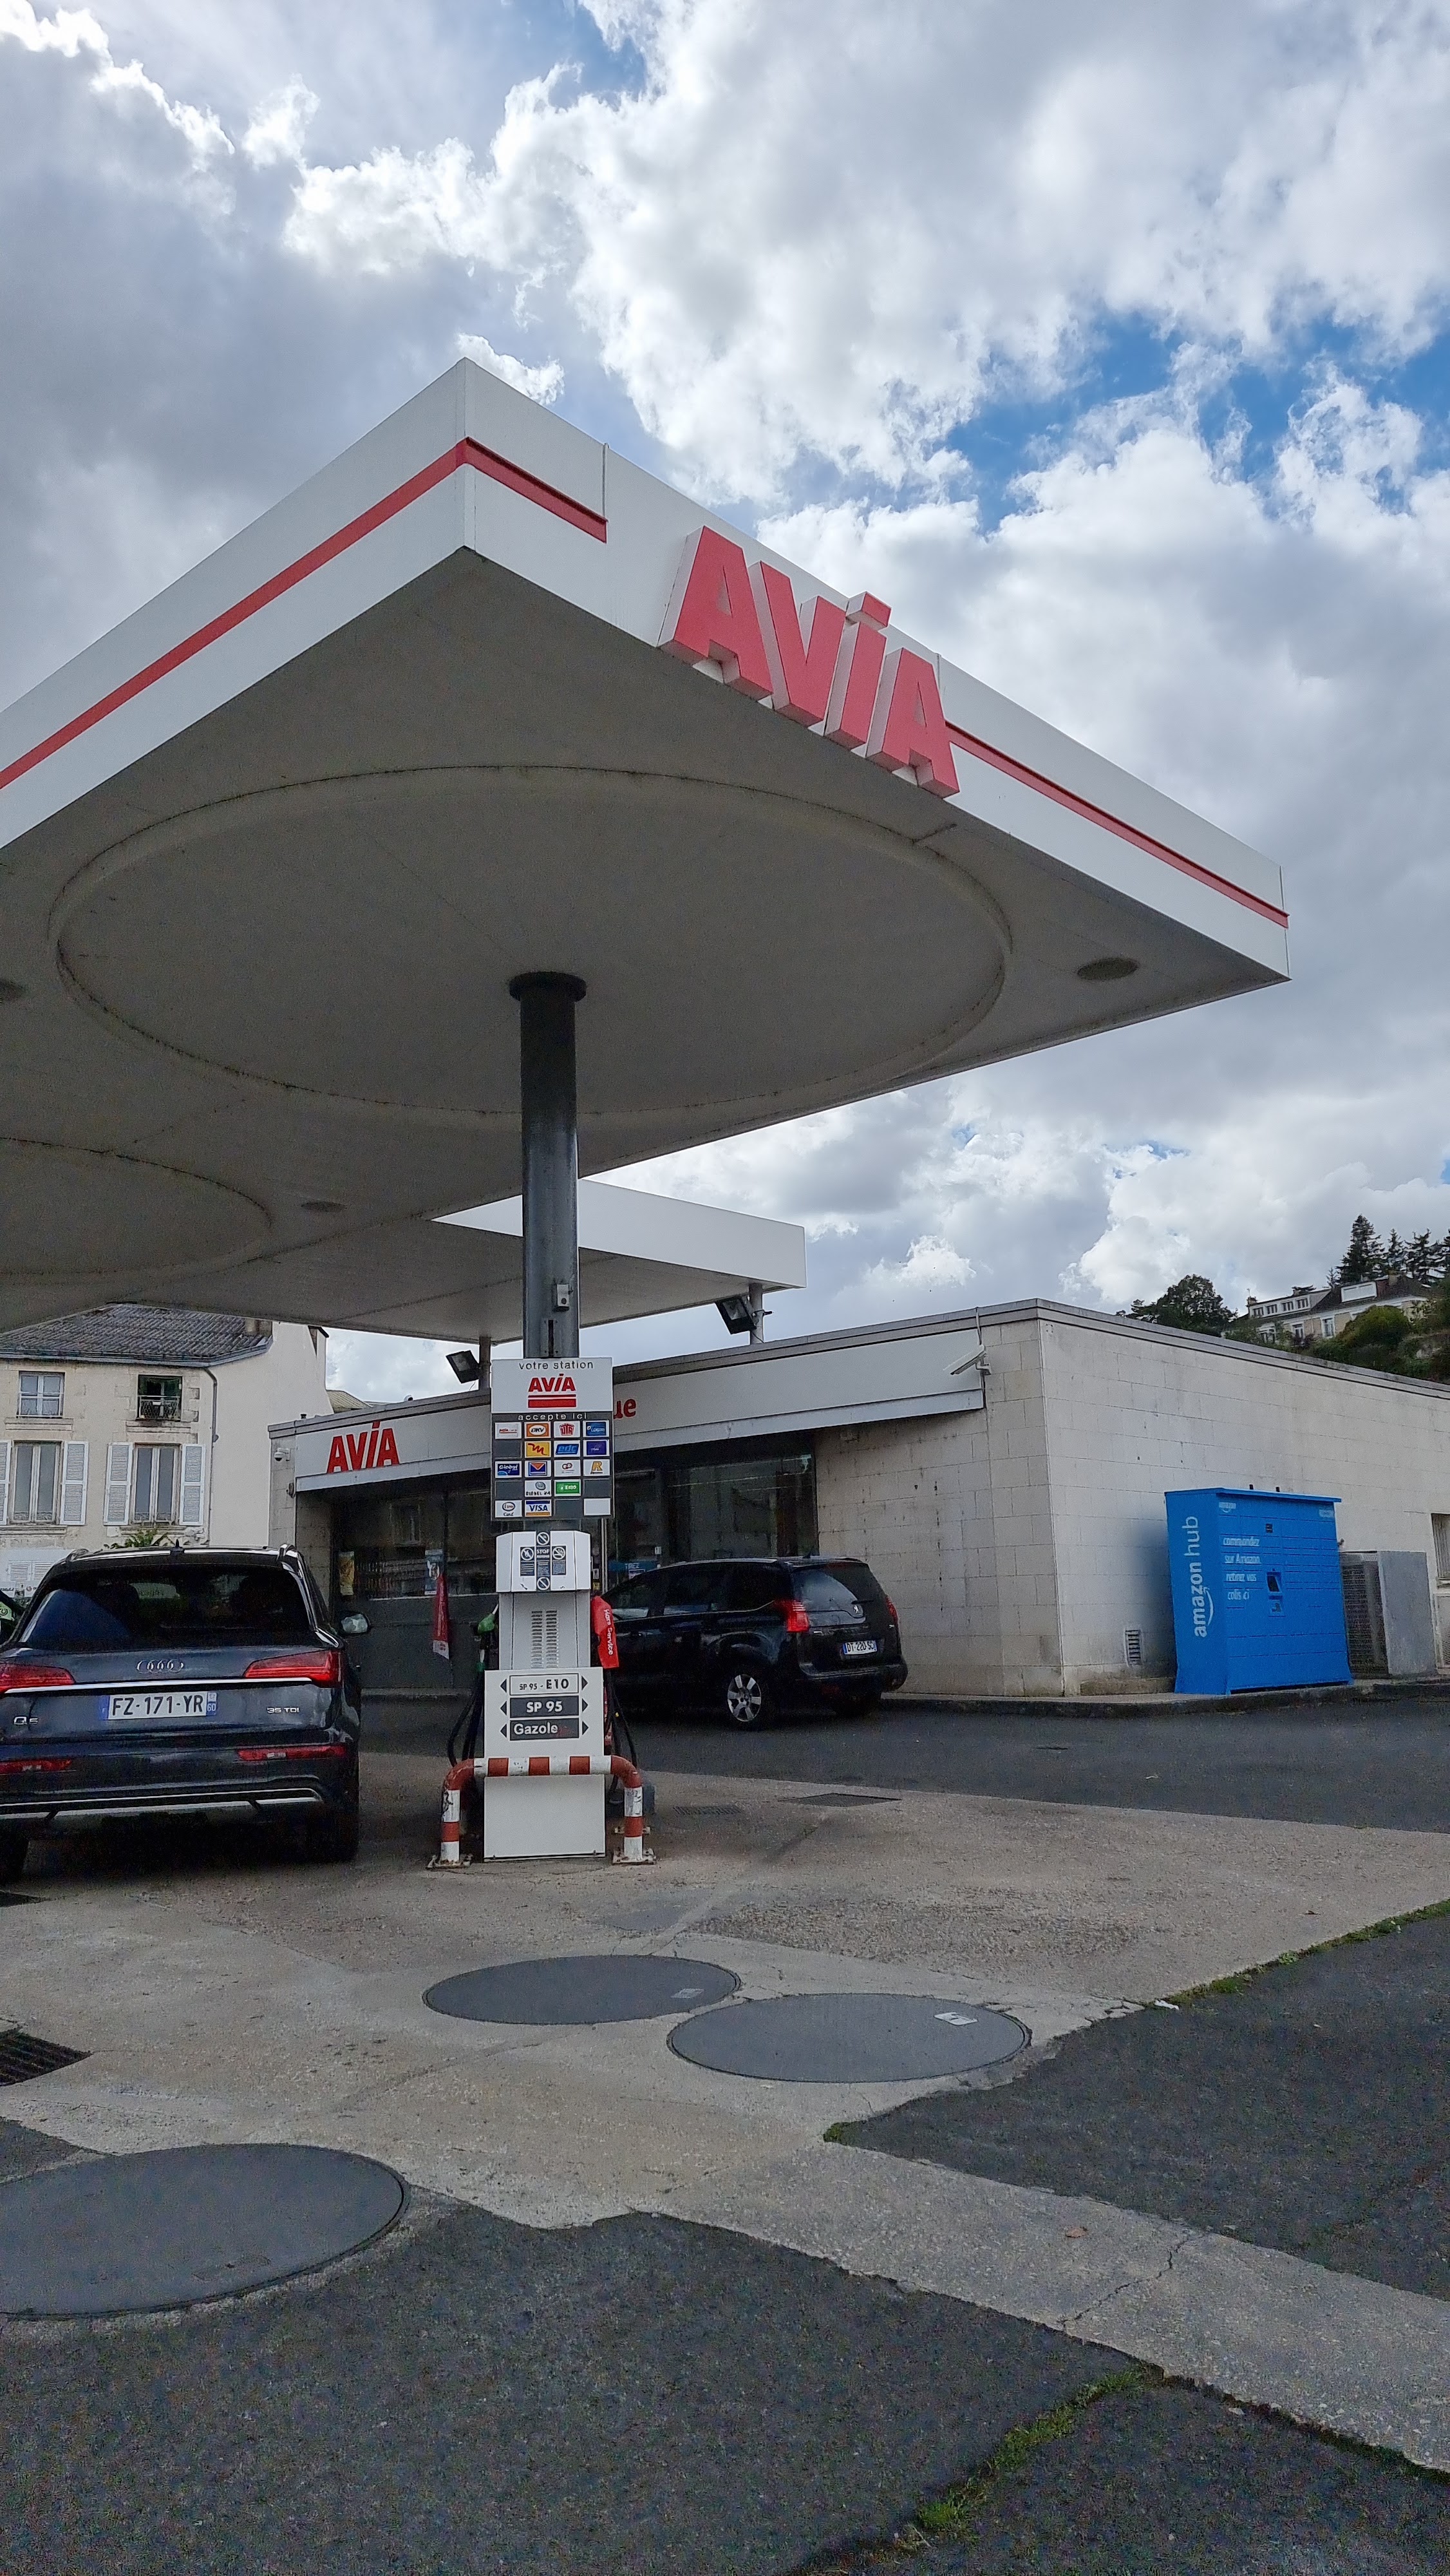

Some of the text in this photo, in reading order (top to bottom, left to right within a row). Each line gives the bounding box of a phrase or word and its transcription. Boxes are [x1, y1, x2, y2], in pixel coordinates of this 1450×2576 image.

[519, 1361, 593, 1370] votre station
[1182, 1516, 1208, 1638] amazon hub
[112, 1694, 203, 1716] FZ-171-YR
[207, 1703, 216, 1712] 60
[526, 1701, 563, 1713] SP 95
[513, 1721, 558, 1735] Gazole
